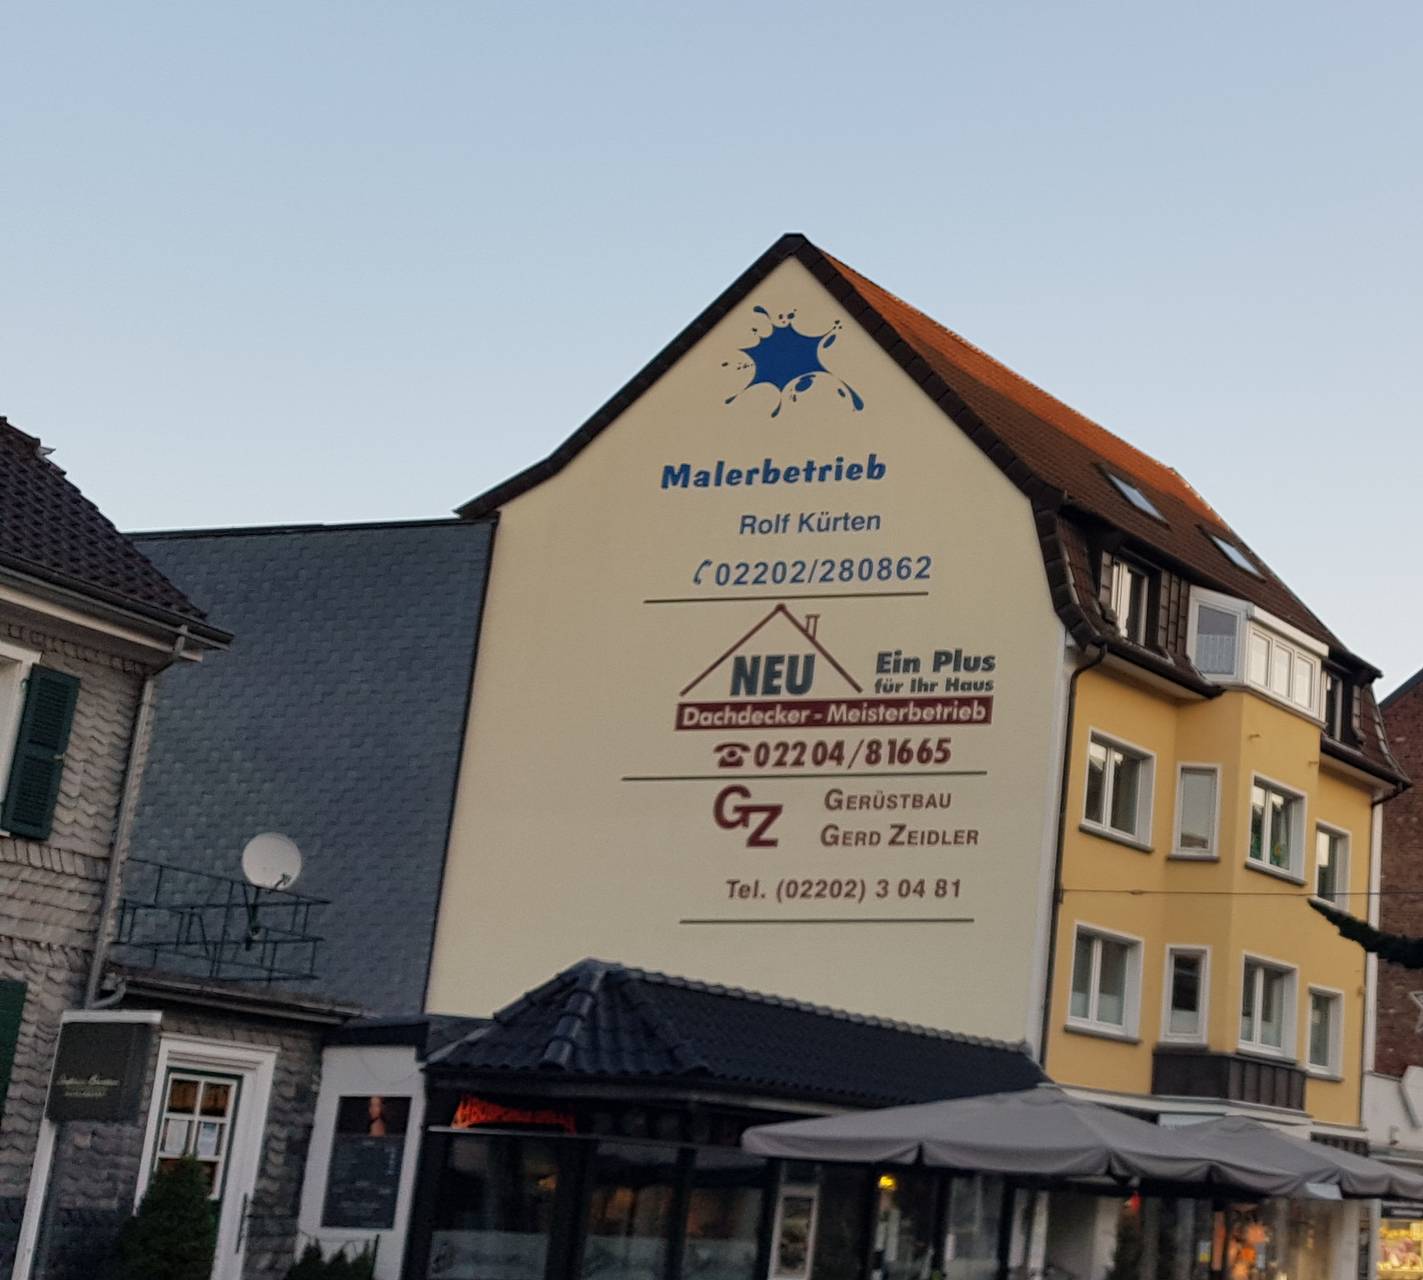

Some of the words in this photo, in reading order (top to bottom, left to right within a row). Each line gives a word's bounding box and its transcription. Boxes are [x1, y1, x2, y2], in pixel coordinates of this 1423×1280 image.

[661, 454, 886, 489] Malerbetrieb
[739, 514, 790, 535] Rolf
[798, 511, 881, 533] Kürten
[714, 555, 932, 587] 02202/280862
[875, 650, 921, 674] Ein
[932, 648, 996, 673] Plus
[730, 654, 816, 697] NEU
[874, 678, 904, 694] für
[909, 677, 939, 693] Ihr
[944, 676, 994, 693] Haus
[683, 706, 810, 728] Dachdecker
[827, 699, 987, 725] Meisterbetrieb
[726, 879, 766, 900] Tel.
[776, 878, 866, 904] (02202)
[875, 878, 890, 899] 3
[897, 878, 926, 899] 04
[934, 878, 961, 899] 81
